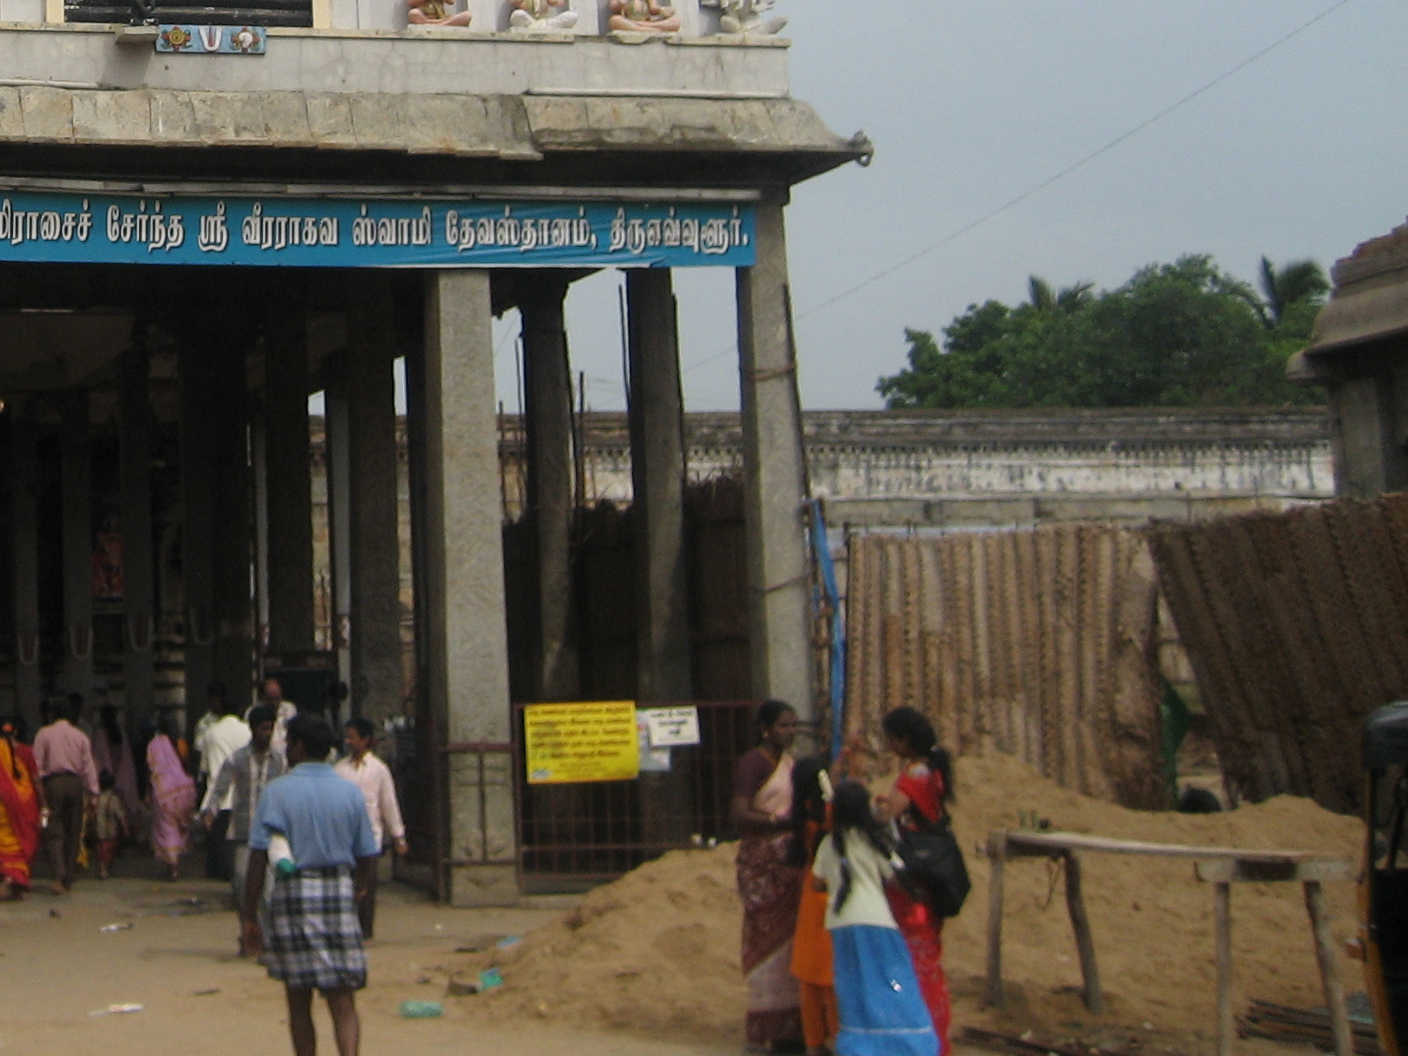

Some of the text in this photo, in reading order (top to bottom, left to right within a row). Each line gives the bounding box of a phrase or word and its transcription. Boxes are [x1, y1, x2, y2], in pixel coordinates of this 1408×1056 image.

[106, 199, 185, 253] சேர்ந்த
[198, 200, 229, 252] ஸ்ரீ
[242, 202, 340, 251] வீரராகவ
[352, 203, 432, 246] ஸ்வாமி
[446, 204, 597, 254] தேவஸ்தானம்,
